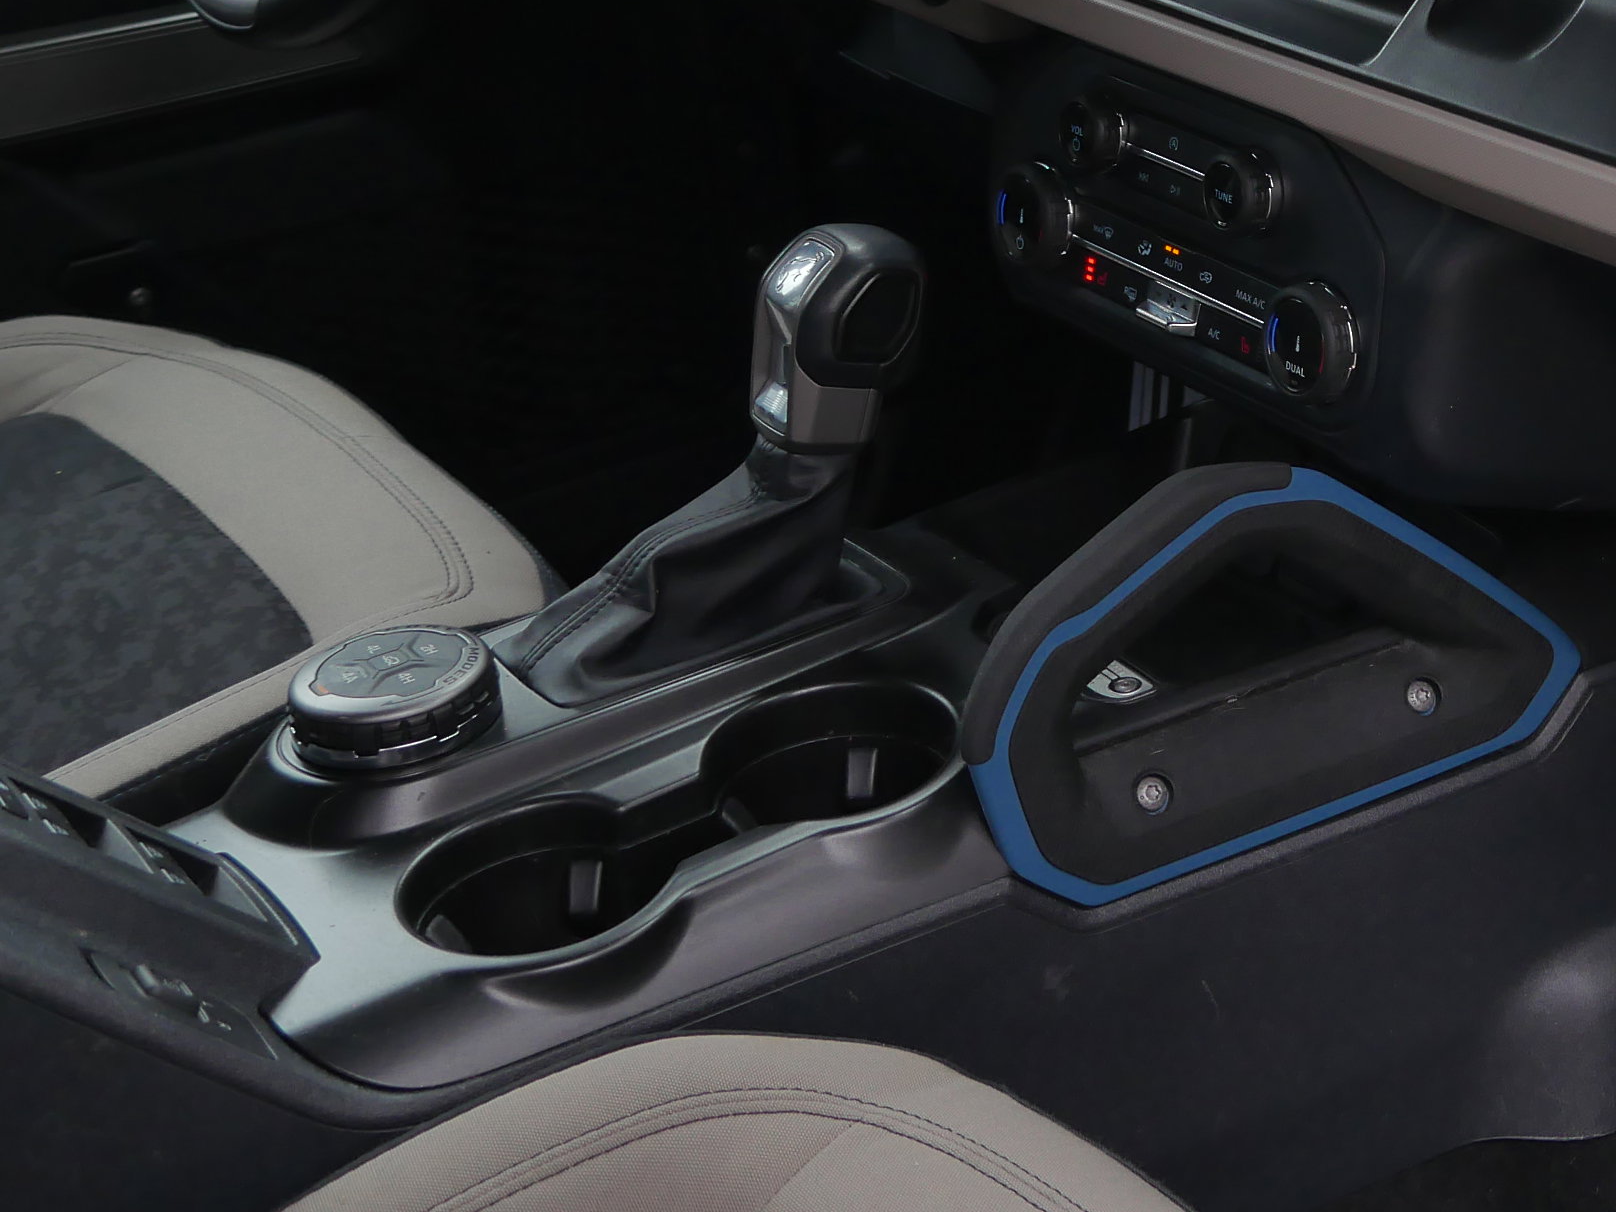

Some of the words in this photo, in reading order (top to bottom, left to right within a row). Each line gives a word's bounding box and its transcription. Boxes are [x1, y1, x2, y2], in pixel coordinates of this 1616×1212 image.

[1071, 124, 1084, 137] VOL
[1215, 189, 1233, 204] TUNE
[1164, 257, 1183, 272] AUTO
[1235, 289, 1252, 303] MAX
[1252, 296, 1266, 310] A/C
[1207, 328, 1221, 340] A/C
[1285, 361, 1305, 378] DUAL
[367, 644, 381, 654] 4L
[420, 644, 439, 655] 2H
[443, 647, 480, 686] MODES
[342, 672, 359, 684] 4A
[399, 673, 416, 685] 4H
